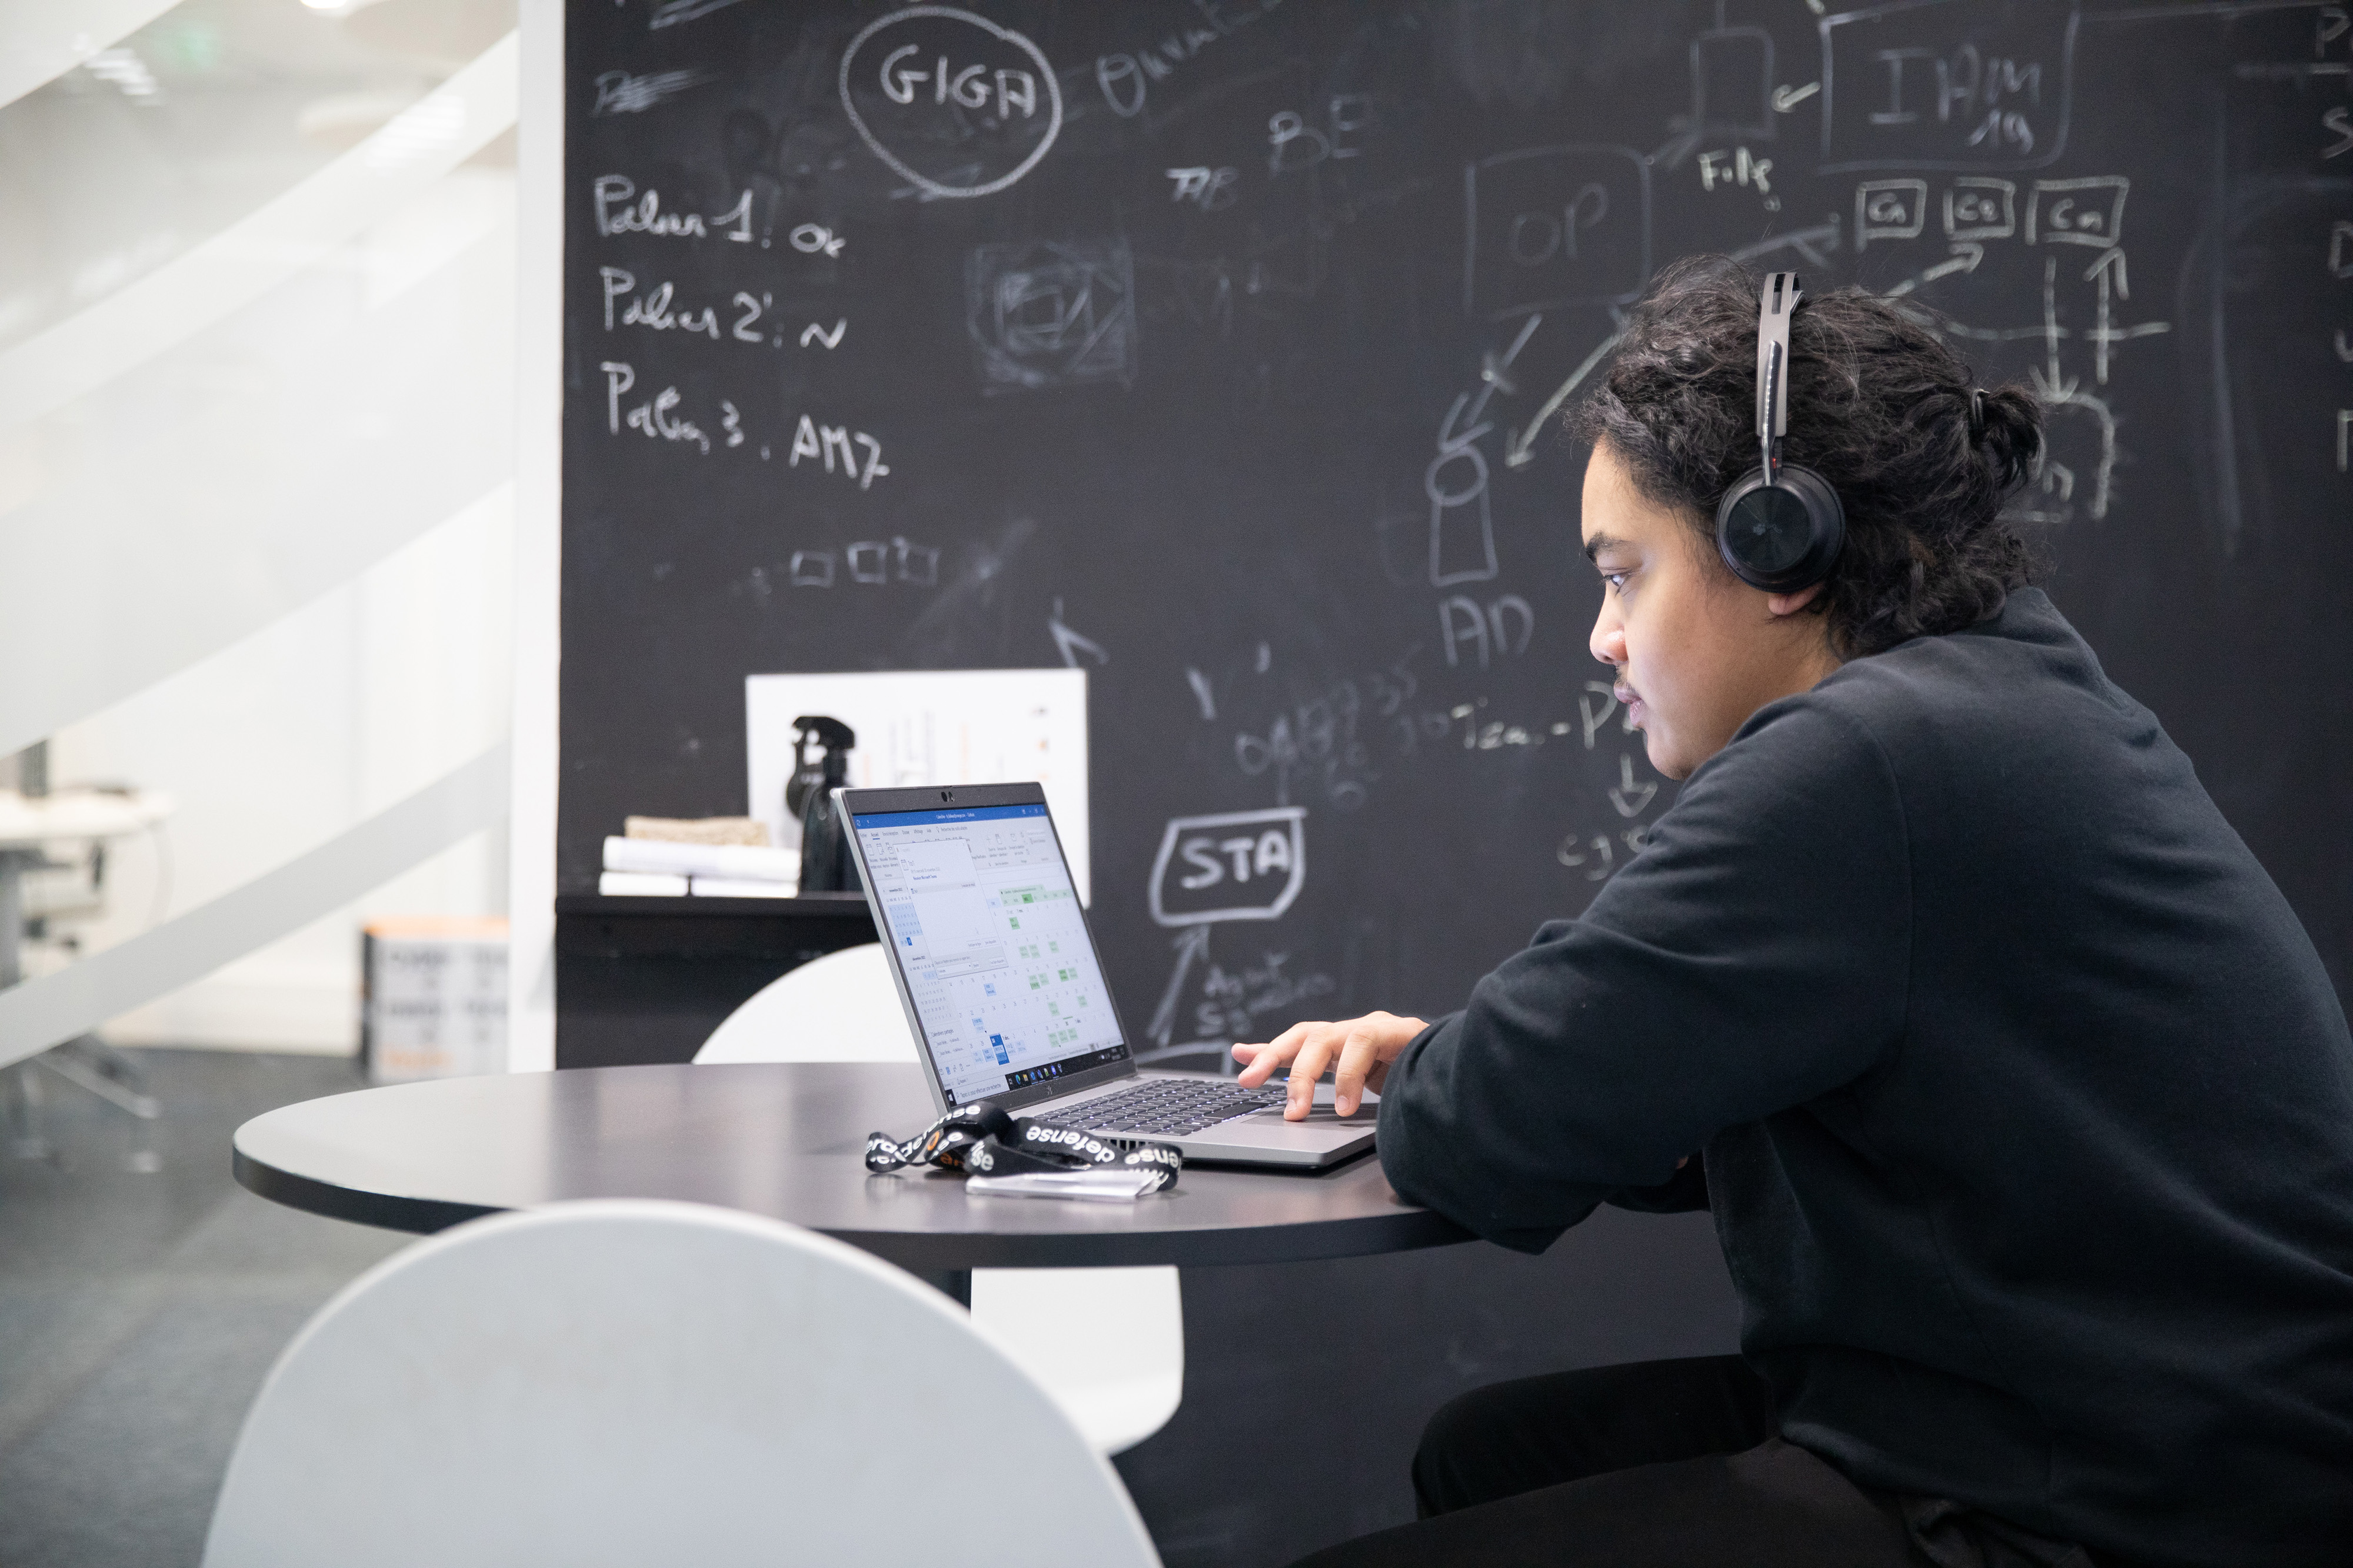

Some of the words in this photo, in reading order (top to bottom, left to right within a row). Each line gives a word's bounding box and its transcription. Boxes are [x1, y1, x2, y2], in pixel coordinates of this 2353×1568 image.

[881, 44, 1037, 121] GIGA
[1179, 829, 1292, 889] STA
[1026, 1126, 1115, 1163] defense
